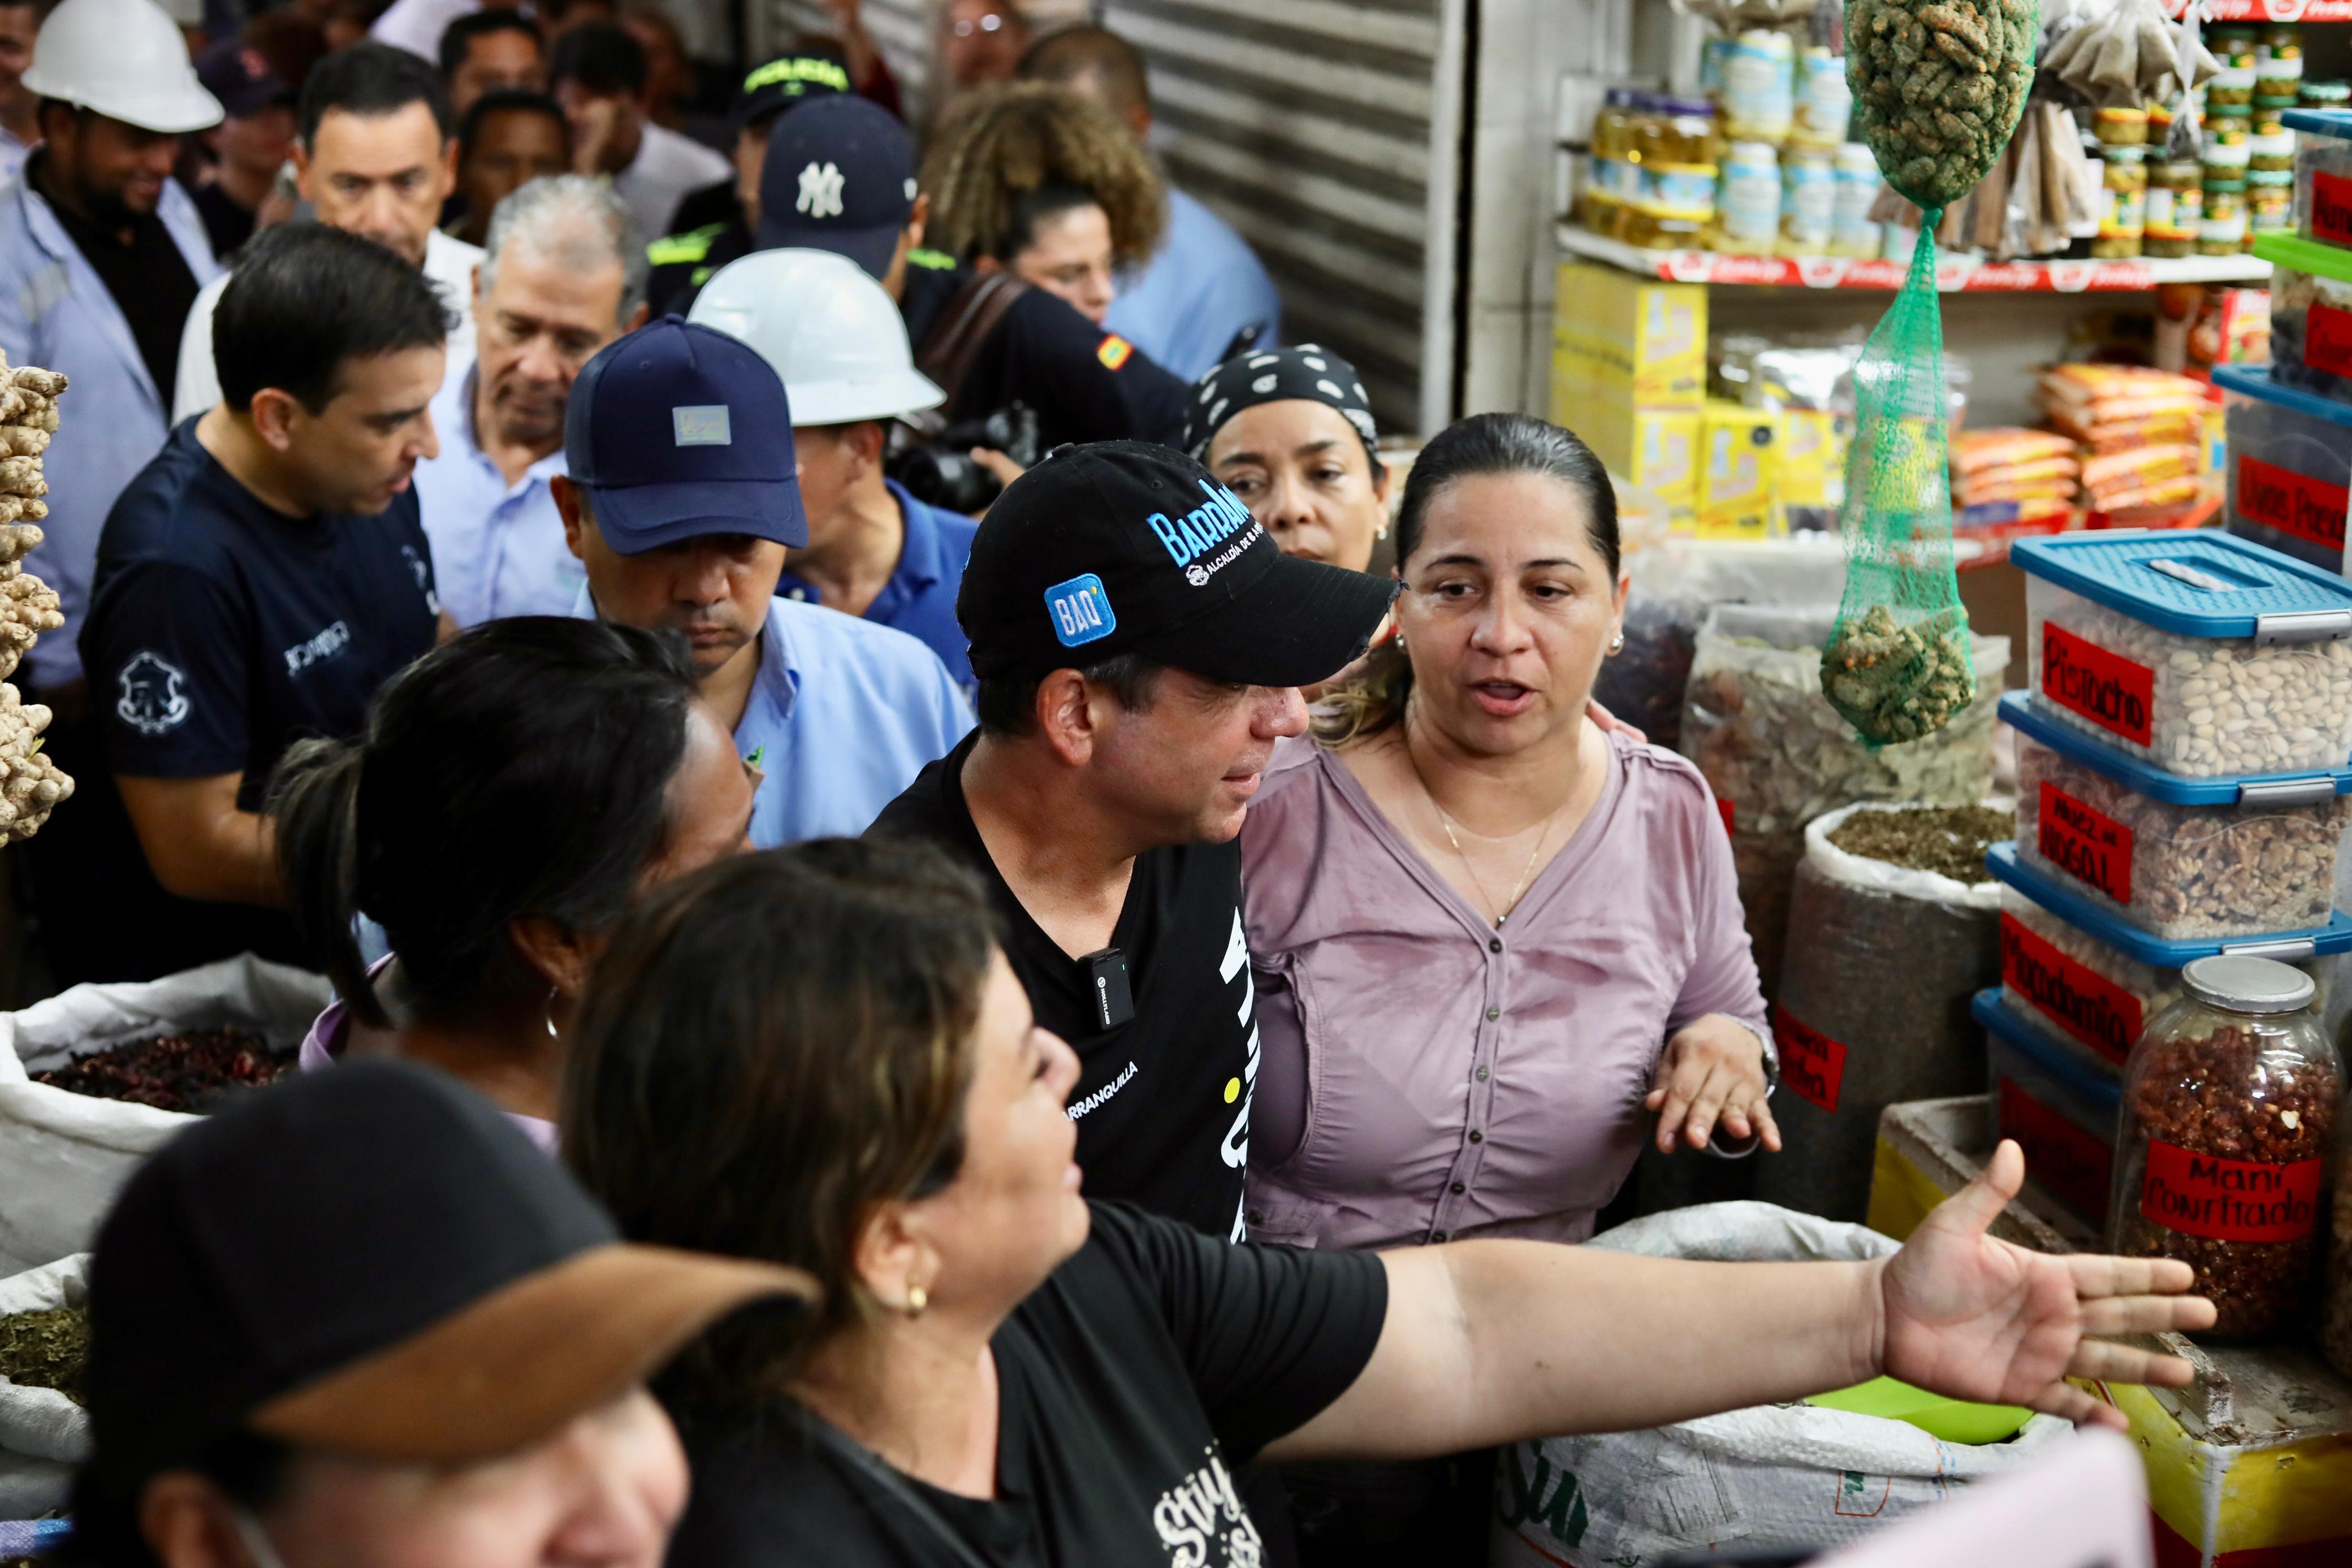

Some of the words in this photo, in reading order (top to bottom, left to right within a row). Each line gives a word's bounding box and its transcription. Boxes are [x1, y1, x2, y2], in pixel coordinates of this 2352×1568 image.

[796, 161, 845, 218] NY
[1207, 544, 1243, 575] ALCALDÍA
[1239, 537, 1251, 550] DE
[1054, 590, 1102, 636] BAQ
[2044, 635, 2144, 730] Pistacho
[1100, 988, 1110, 1025] HOLLYLAND
[2189, 1158, 2289, 1193] Maní
